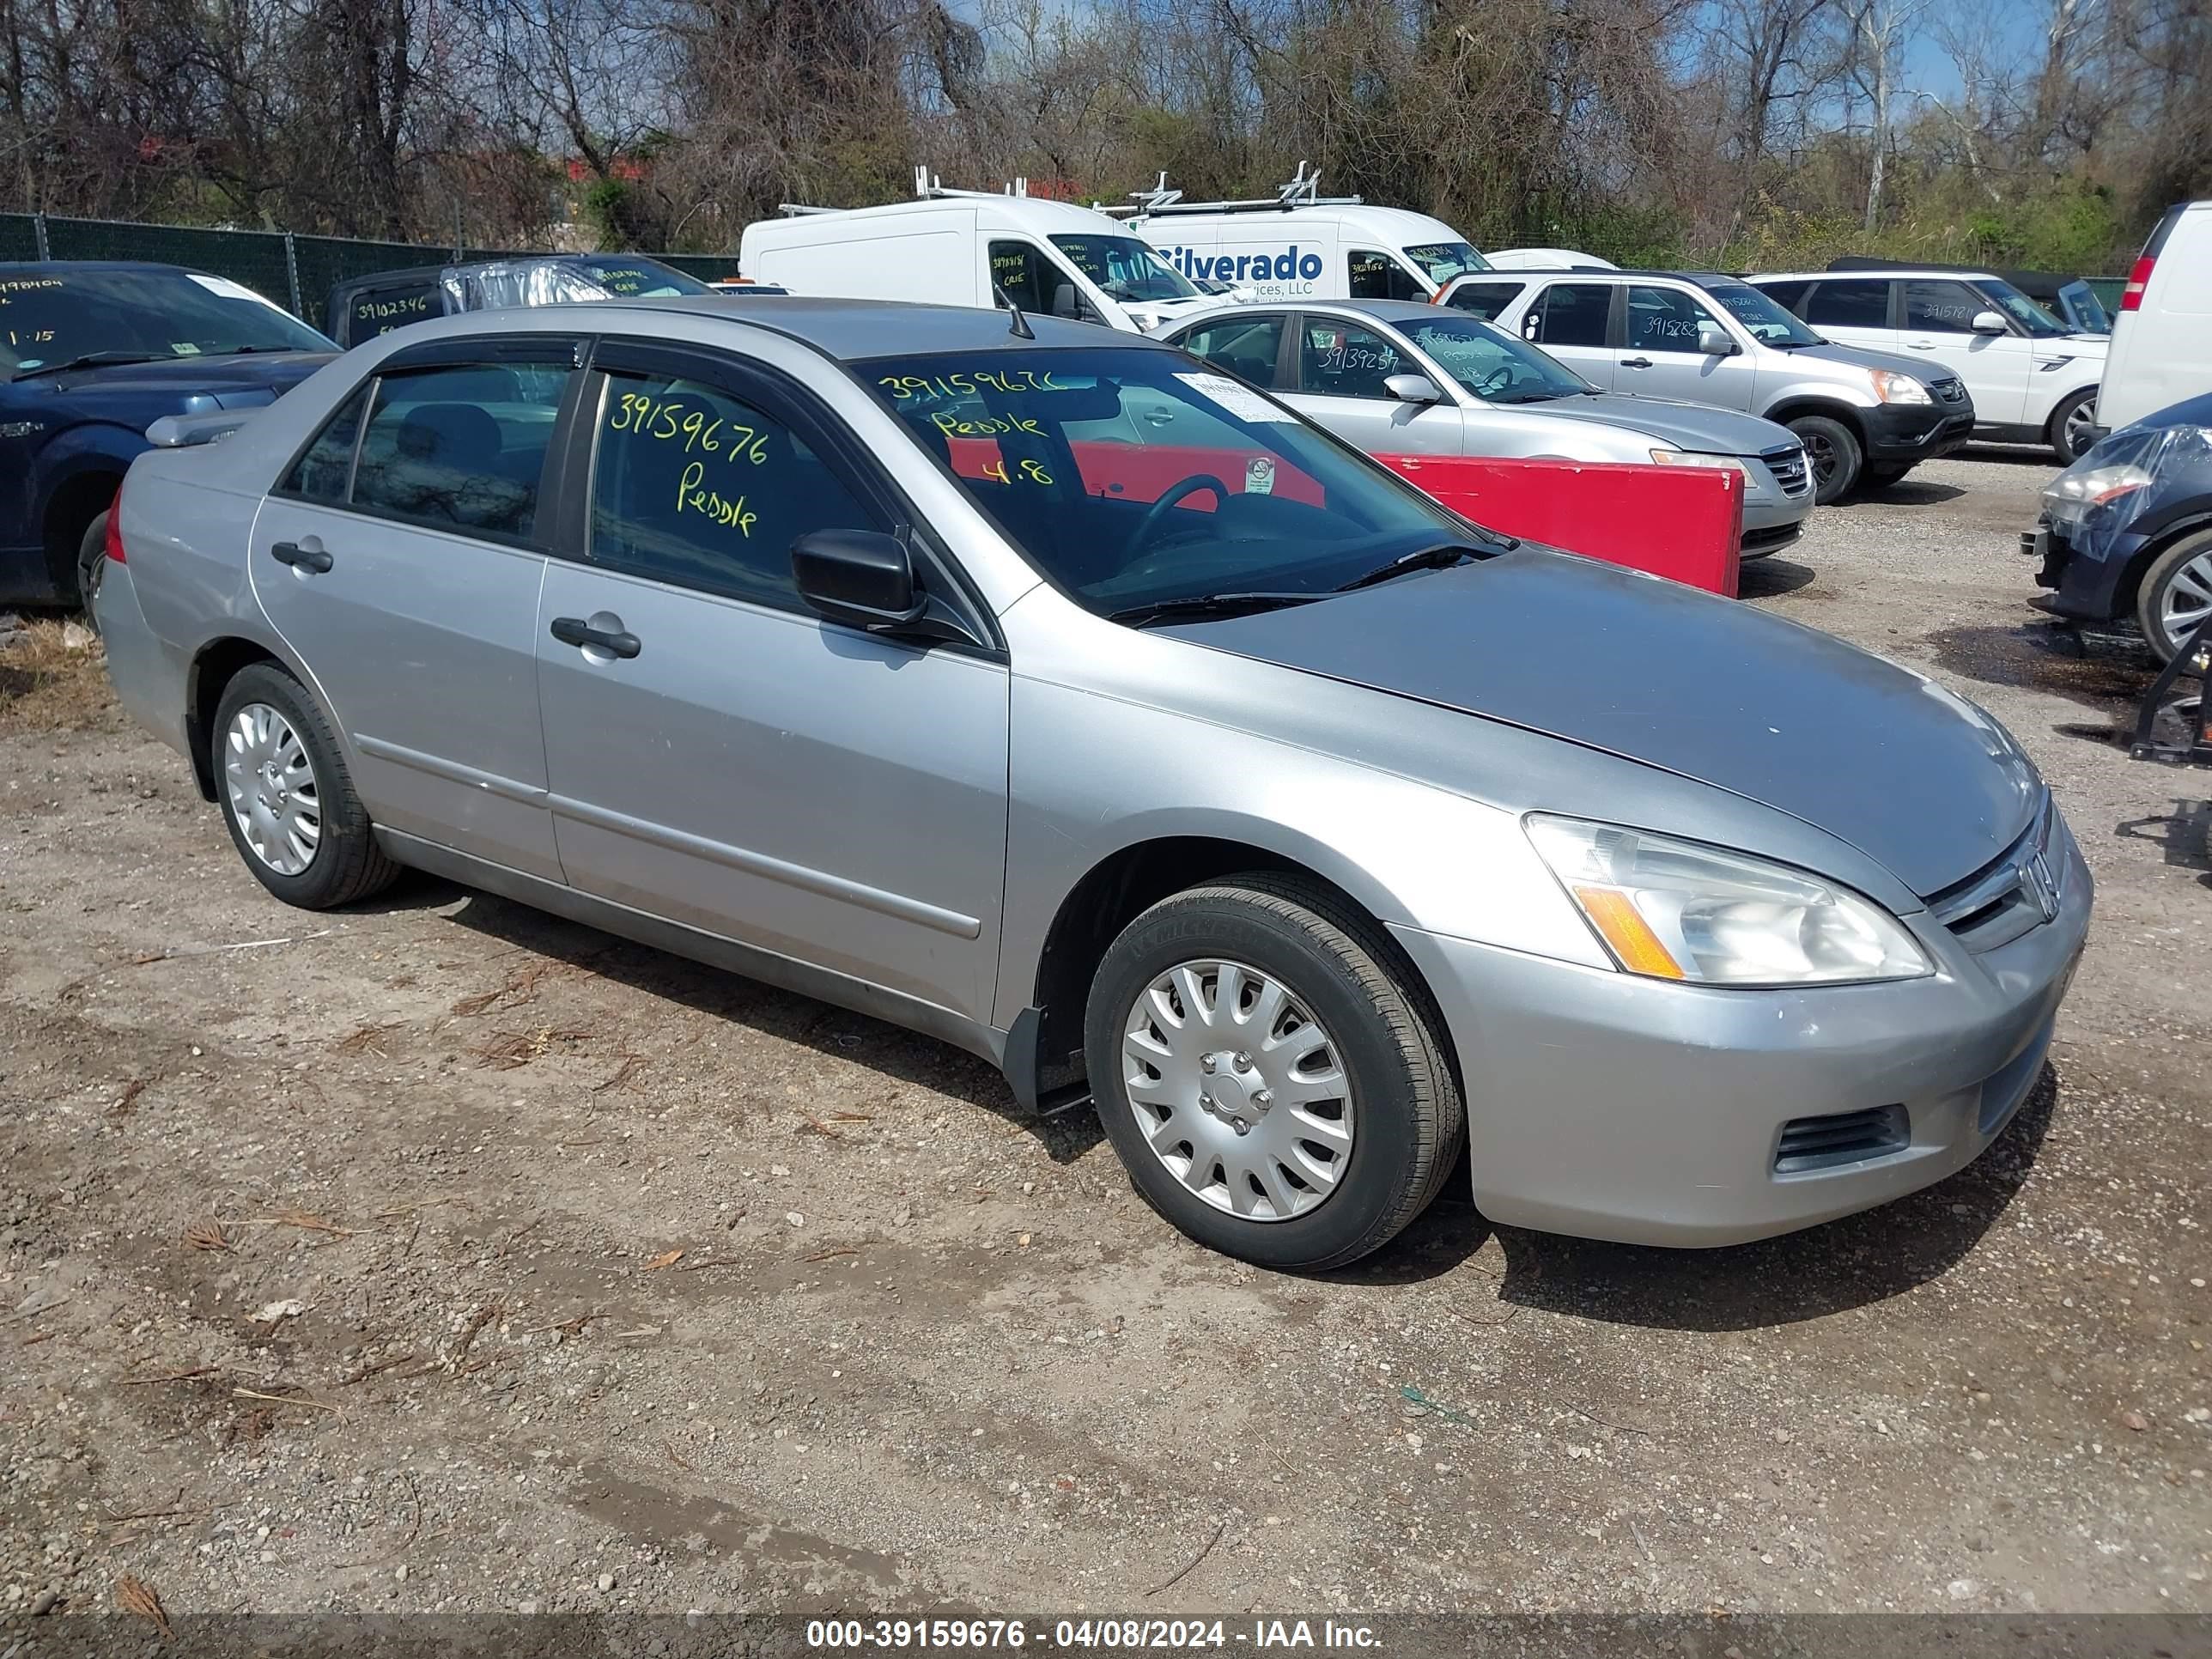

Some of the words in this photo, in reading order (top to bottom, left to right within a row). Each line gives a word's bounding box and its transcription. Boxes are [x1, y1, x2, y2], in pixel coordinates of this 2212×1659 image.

[1253, 283, 1285, 297] ices,
[1288, 282, 1313, 295] LLC
[358, 295, 428, 319] 39102346
[1317, 345, 1400, 374] 39139257
[878, 370, 1068, 399] 39159676
[611, 392, 770, 465] 39159676
